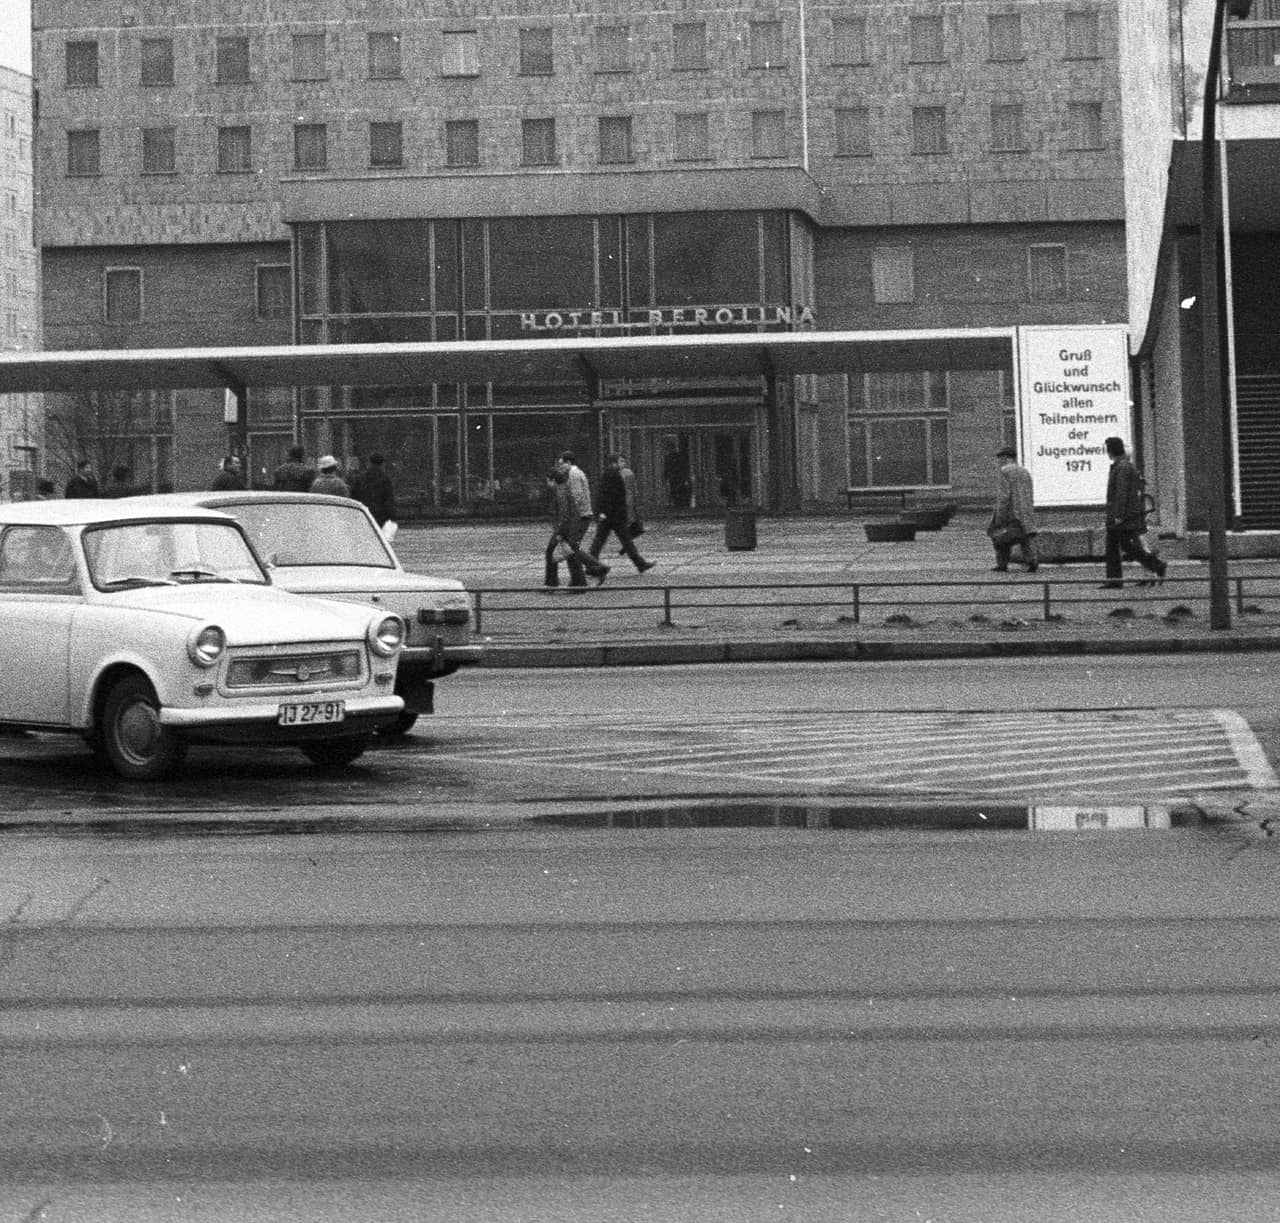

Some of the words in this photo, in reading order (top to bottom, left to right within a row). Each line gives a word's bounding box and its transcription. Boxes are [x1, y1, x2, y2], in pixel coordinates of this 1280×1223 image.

[521, 311, 620, 330] HOTEL
[648, 306, 815, 327] BEROLINA
[1059, 349, 1092, 362] Gruß
[1064, 365, 1088, 377] und
[1033, 380, 1121, 394] Glückwunsch
[1062, 397, 1093, 409] allen
[1039, 413, 1118, 425] Teilnehmern
[1068, 429, 1089, 441] der
[1037, 445, 1106, 460] Jugendwei
[1065, 460, 1092, 472] 1971
[301, 704, 340, 722] 27-91
